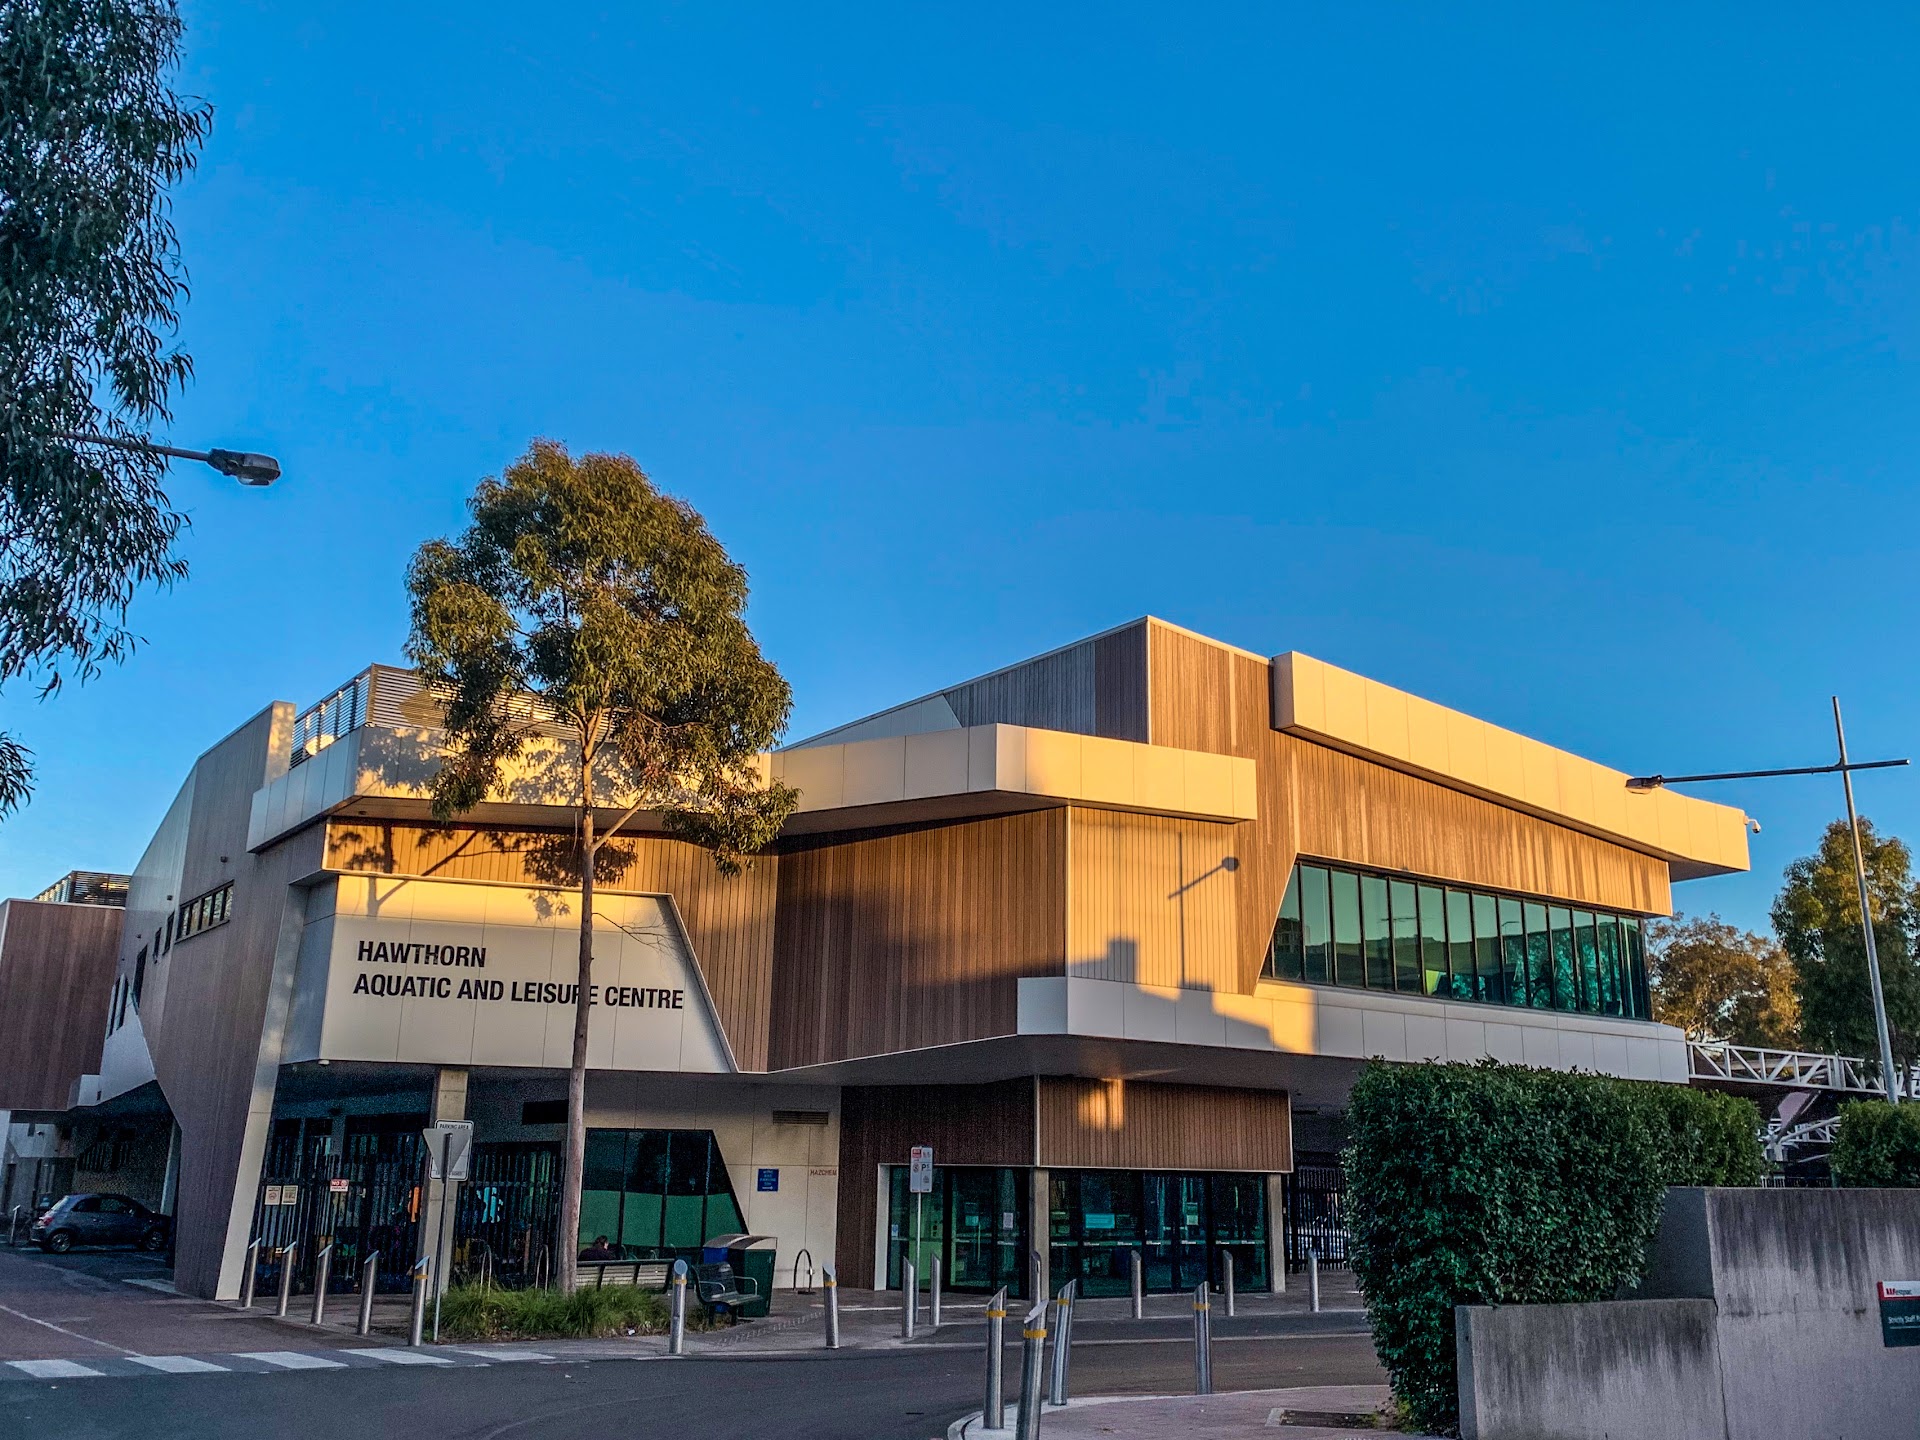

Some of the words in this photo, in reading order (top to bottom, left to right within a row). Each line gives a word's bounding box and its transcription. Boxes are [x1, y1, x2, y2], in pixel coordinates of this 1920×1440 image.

[357, 940, 487, 968] HAWTHORN
[353, 973, 451, 999] AQUATIC
[457, 979, 504, 1001] AND
[604, 986, 684, 1009] CENTRE
